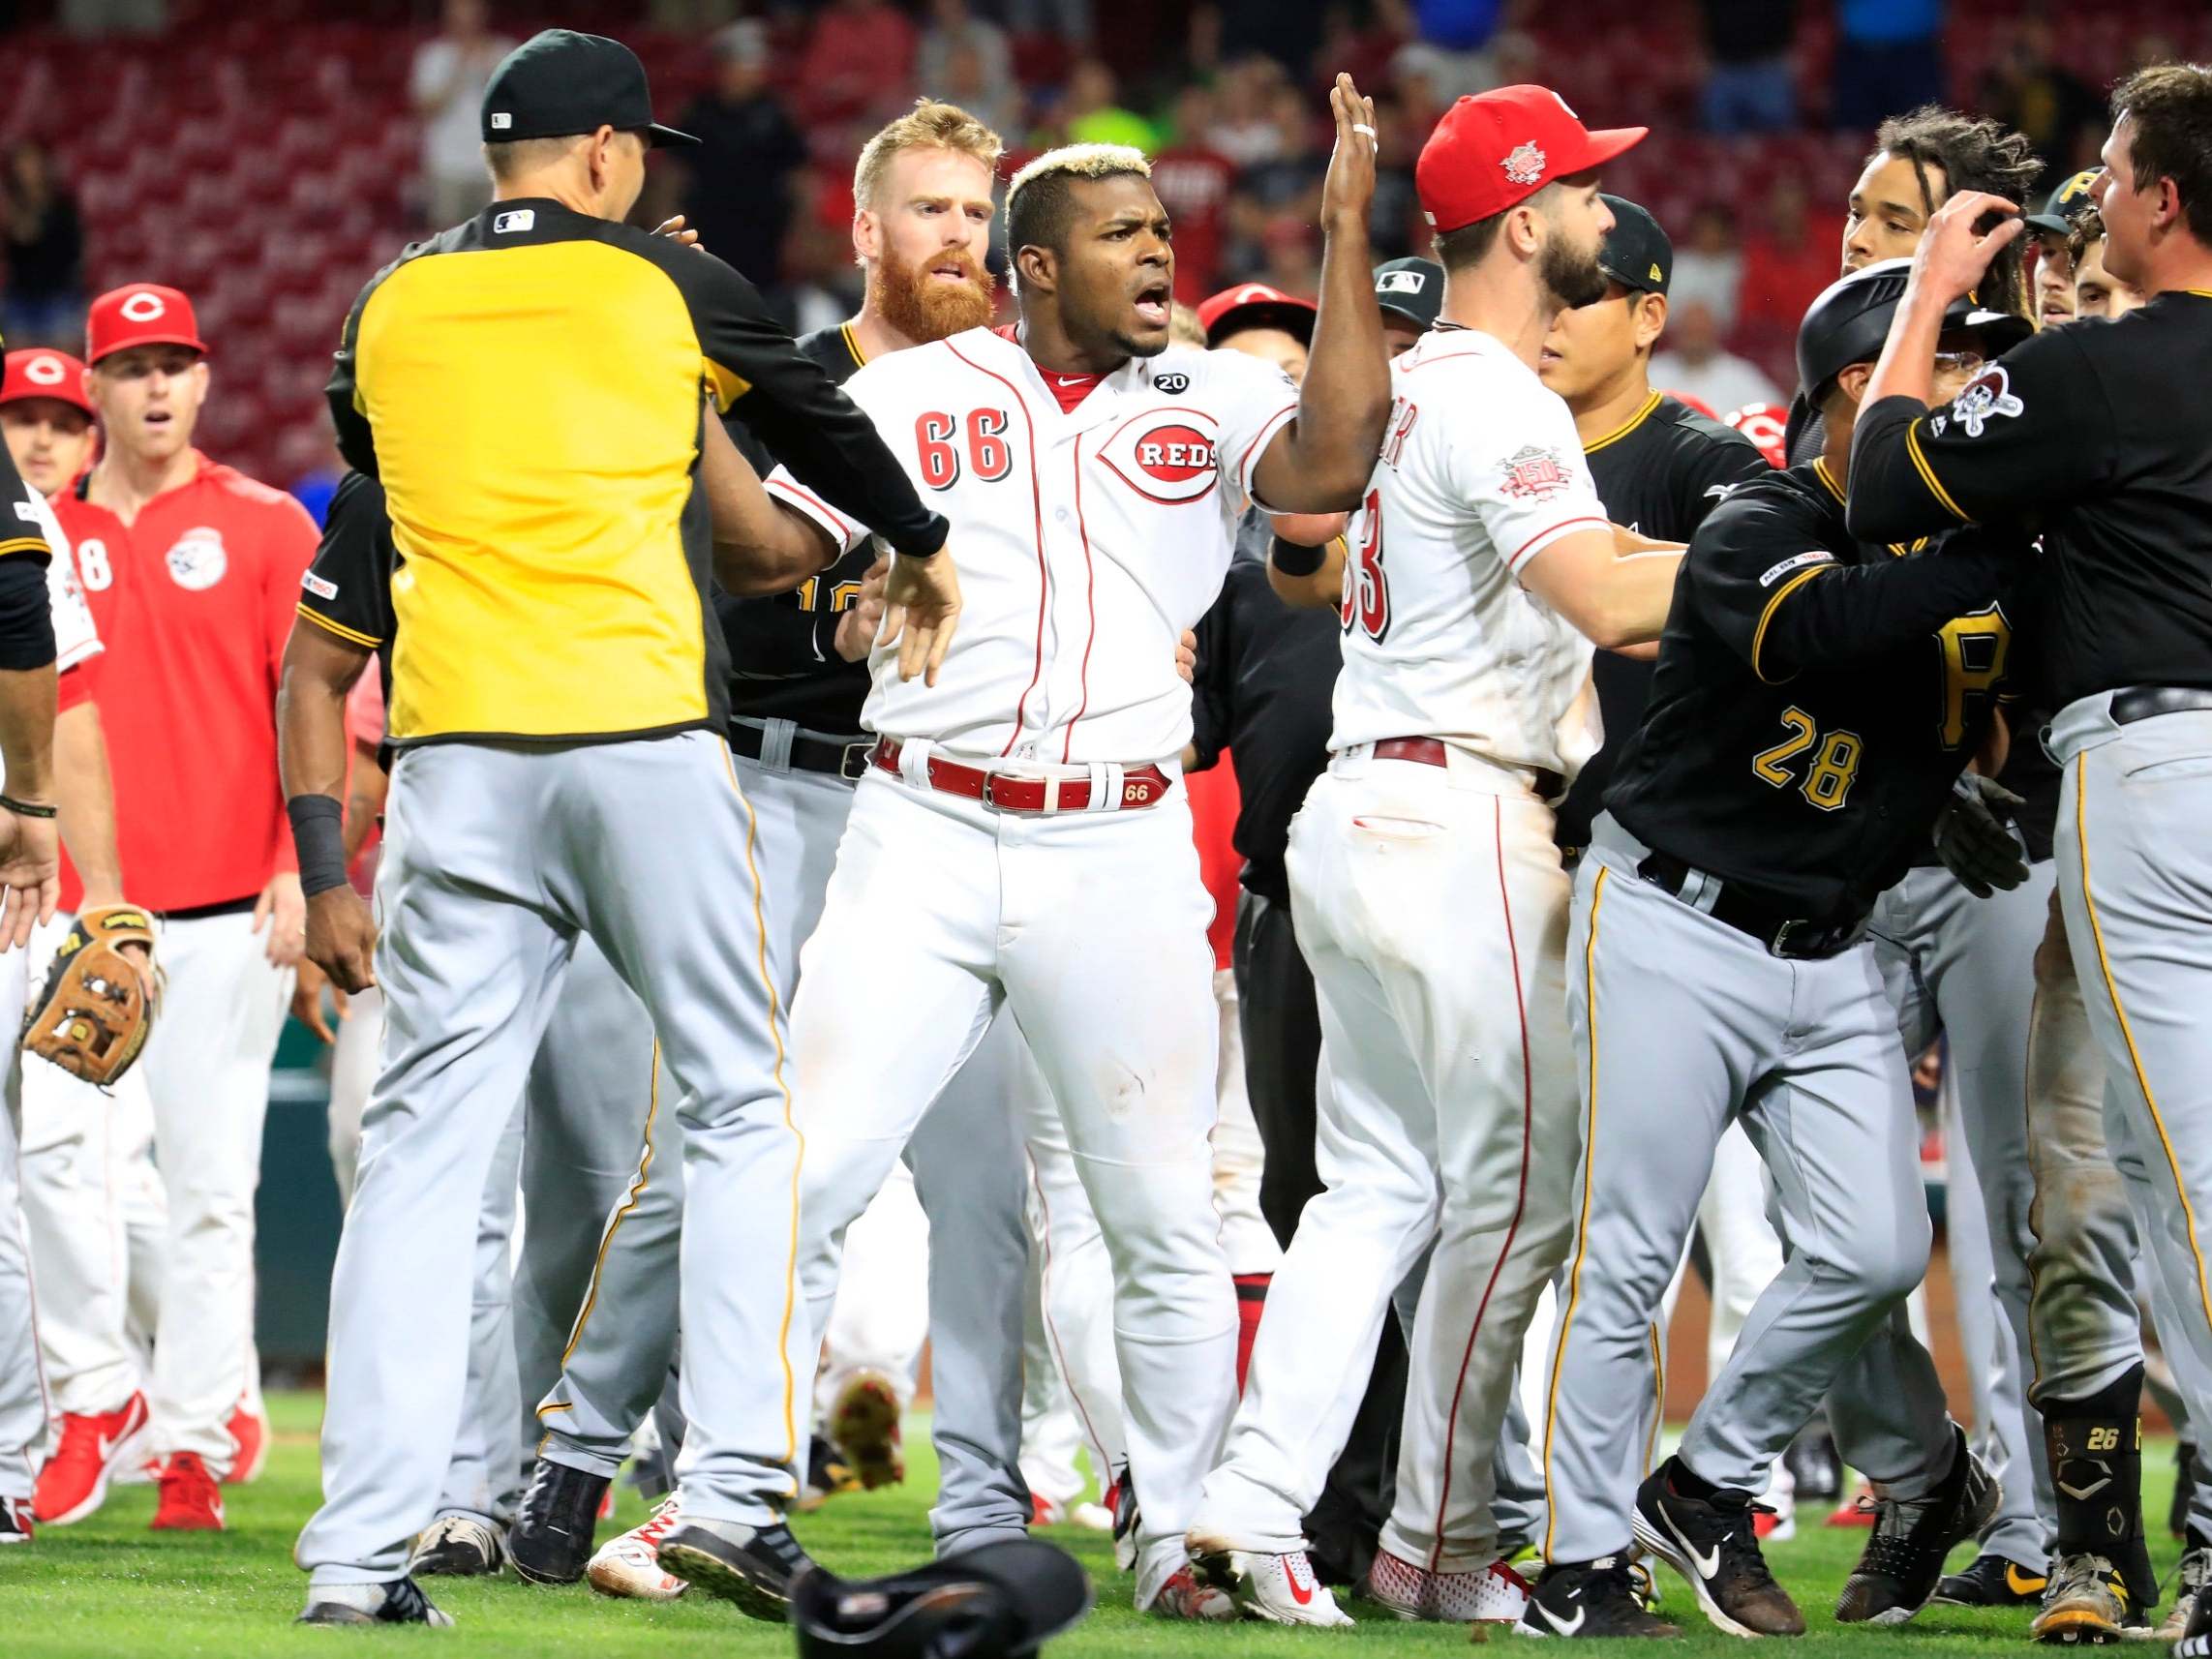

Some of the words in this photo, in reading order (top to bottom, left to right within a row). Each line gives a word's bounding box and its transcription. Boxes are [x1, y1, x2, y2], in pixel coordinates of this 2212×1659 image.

[120, 292, 166, 321] C
[25, 356, 66, 385] C
[1158, 375, 1187, 390] 20
[915, 407, 1013, 492] 66
[1934, 600, 2013, 751] P
[1753, 705, 1863, 811] 28
[1125, 785, 1149, 801] 66
[2086, 1427, 2120, 1450] 26
